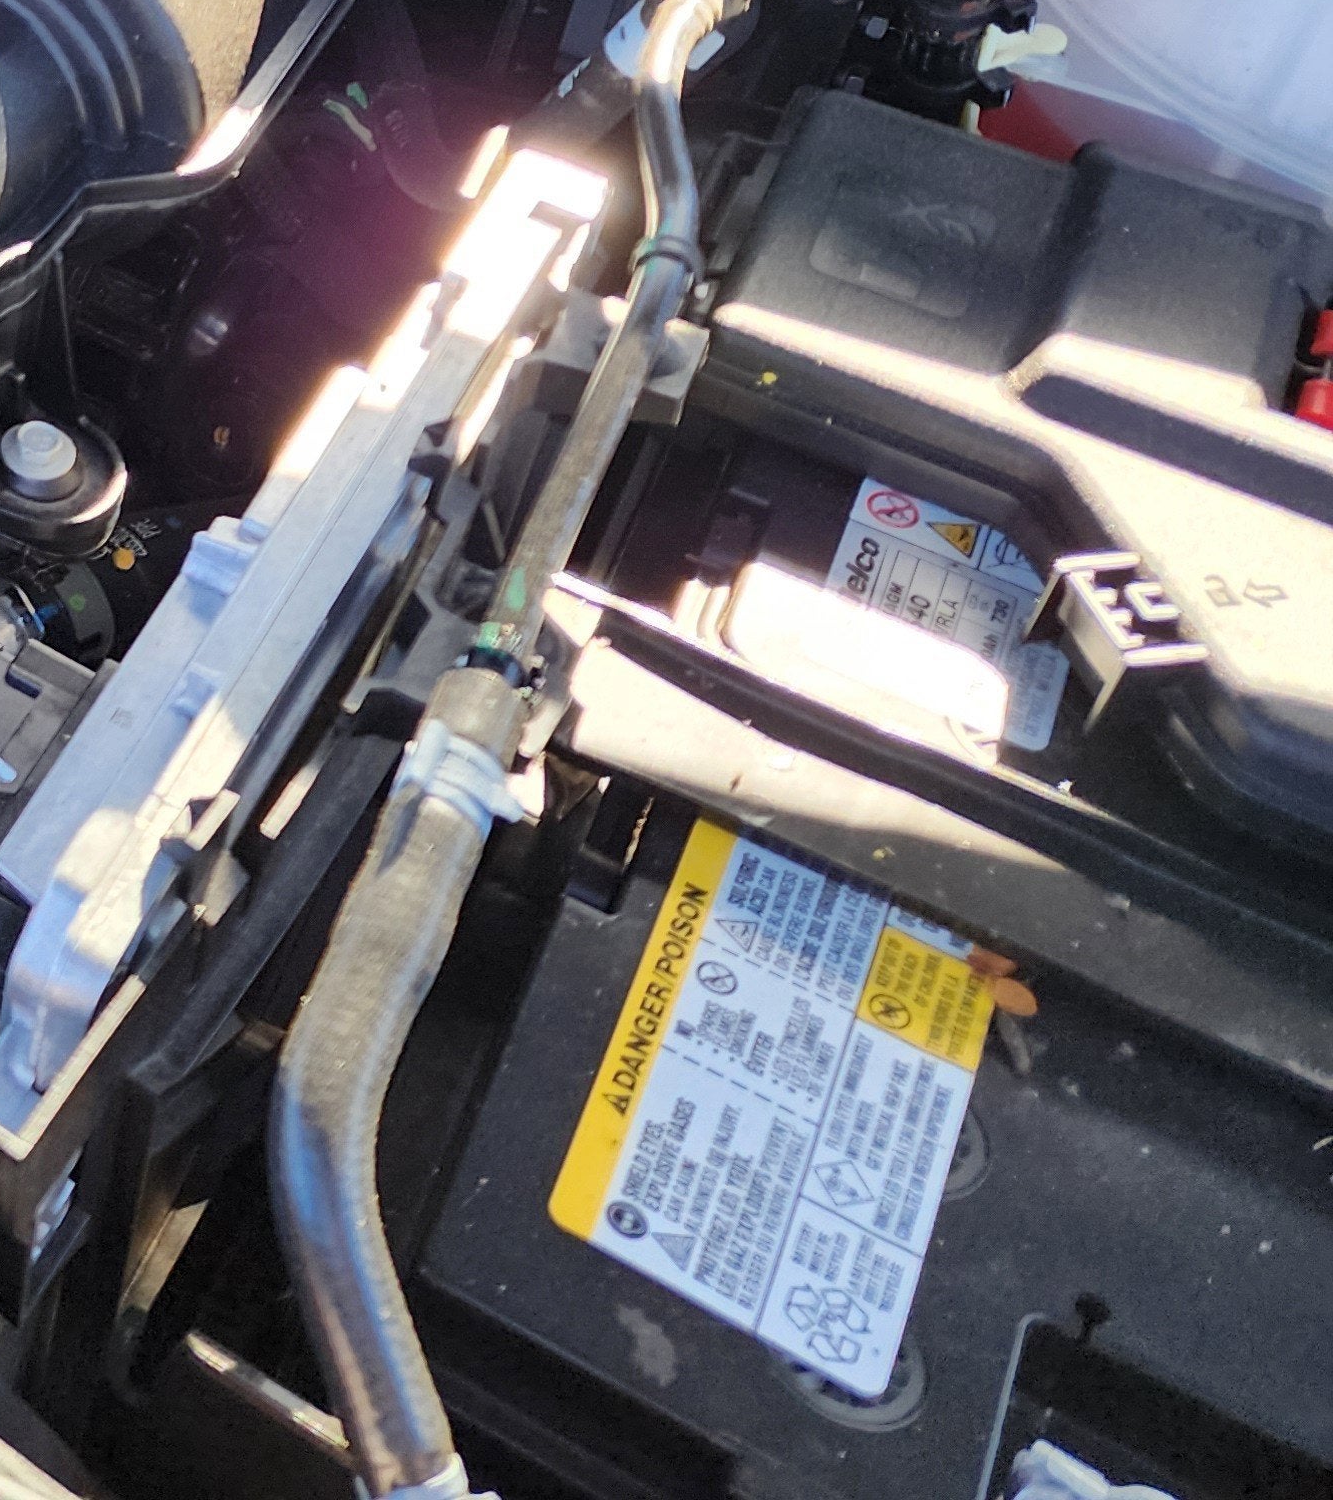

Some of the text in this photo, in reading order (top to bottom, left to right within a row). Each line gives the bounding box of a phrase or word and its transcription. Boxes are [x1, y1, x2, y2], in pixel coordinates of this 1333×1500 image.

[883, 580, 904, 614] AGM
[905, 592, 932, 626] 40
[611, 881, 708, 1093] DANGER/POISON
[641, 1137, 682, 1213] EXPLOSIVE
